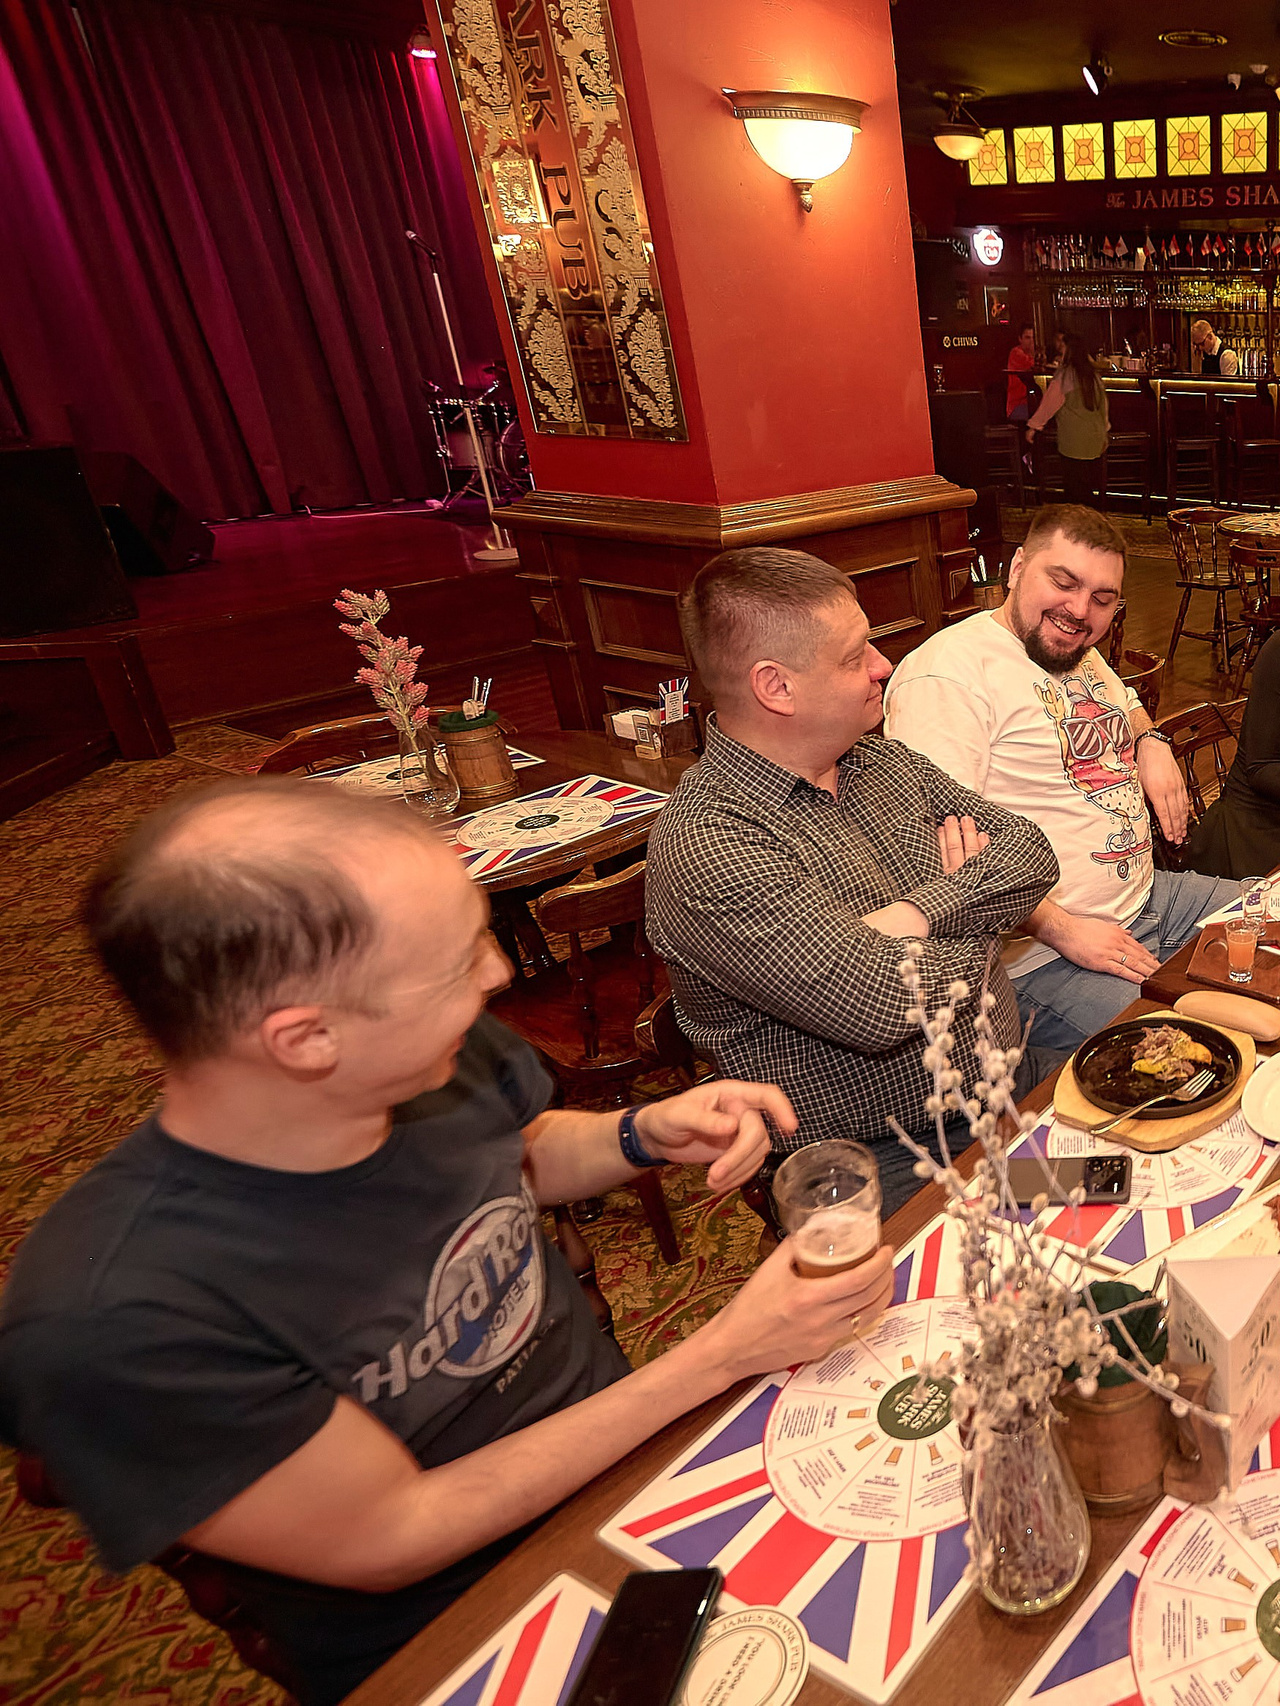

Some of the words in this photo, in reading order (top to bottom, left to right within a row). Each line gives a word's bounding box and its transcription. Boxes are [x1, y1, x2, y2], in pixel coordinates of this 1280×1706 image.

[1132, 188, 1214, 209] JAMES
[540, 162, 592, 300] PUB
[952, 336, 978, 347] CHIVAS
[351, 1256, 491, 1404] Hard
[897, 1384, 939, 1427] SARK
[910, 1389, 947, 1430] JAMES
